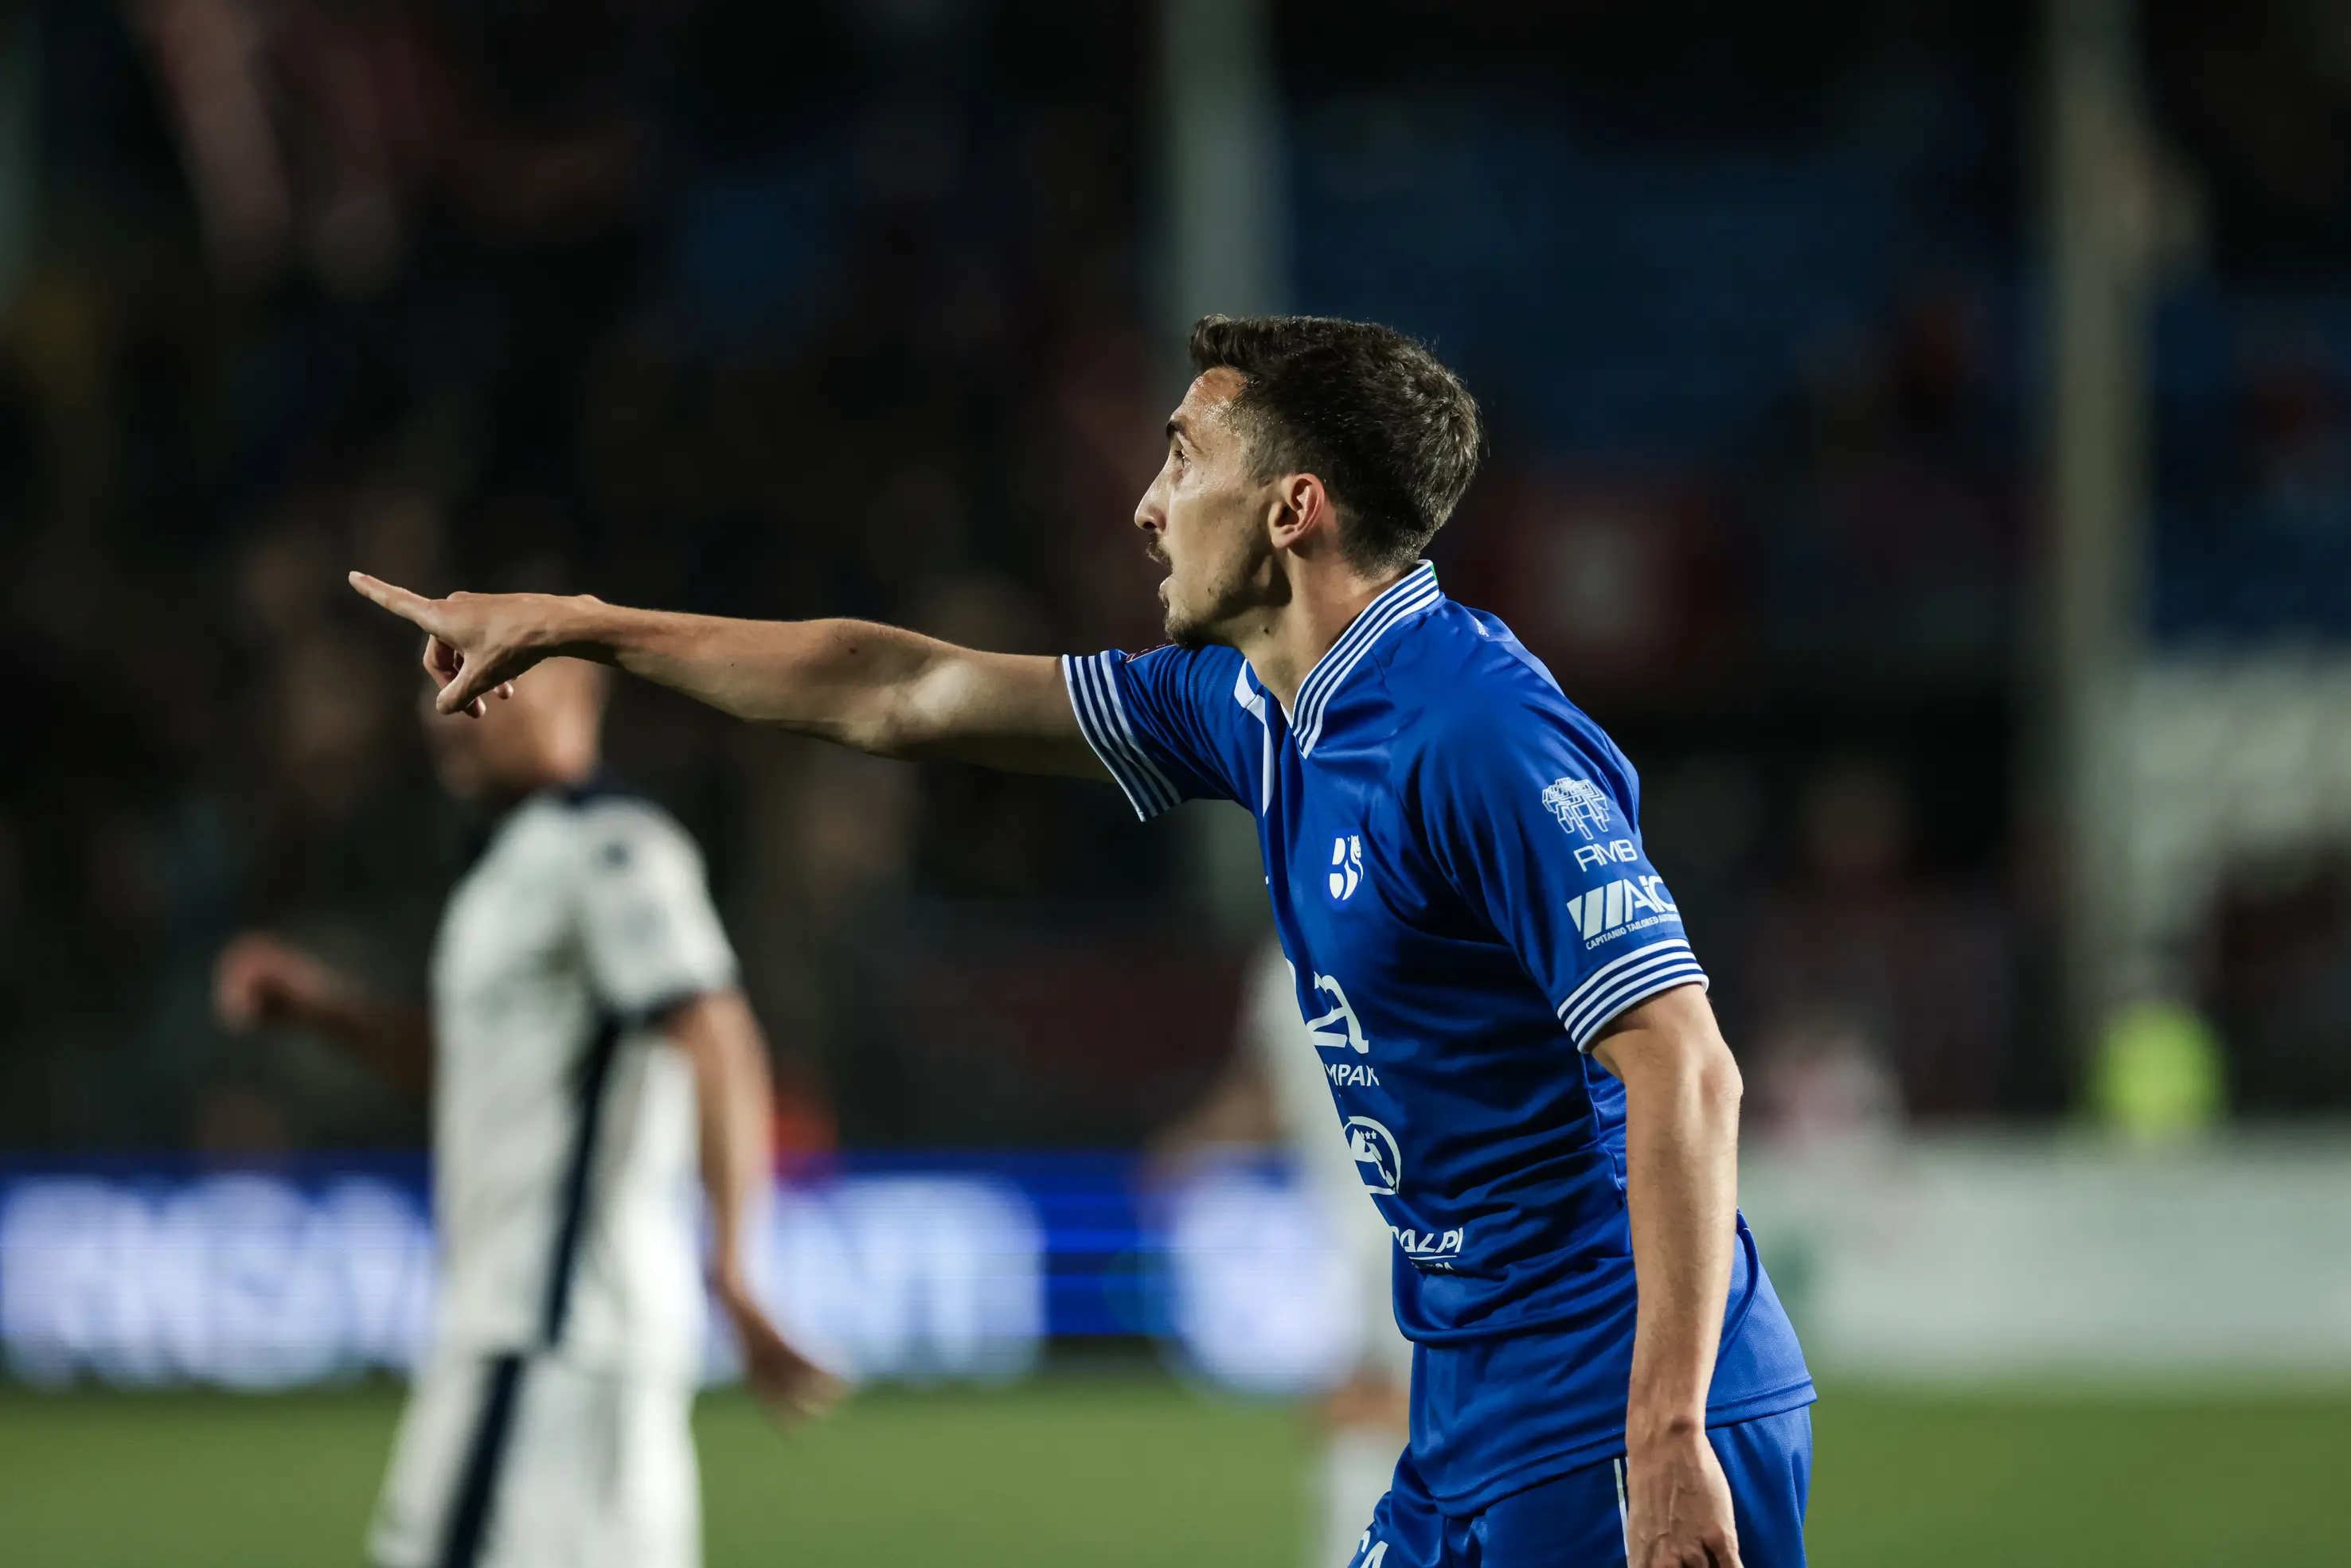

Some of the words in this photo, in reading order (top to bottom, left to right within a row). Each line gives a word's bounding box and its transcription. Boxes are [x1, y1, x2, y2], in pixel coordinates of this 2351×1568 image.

[1573, 839, 1638, 872] RMB
[1586, 926, 1627, 950] CAPITANIO
[1323, 1063, 1380, 1087] MPAN
